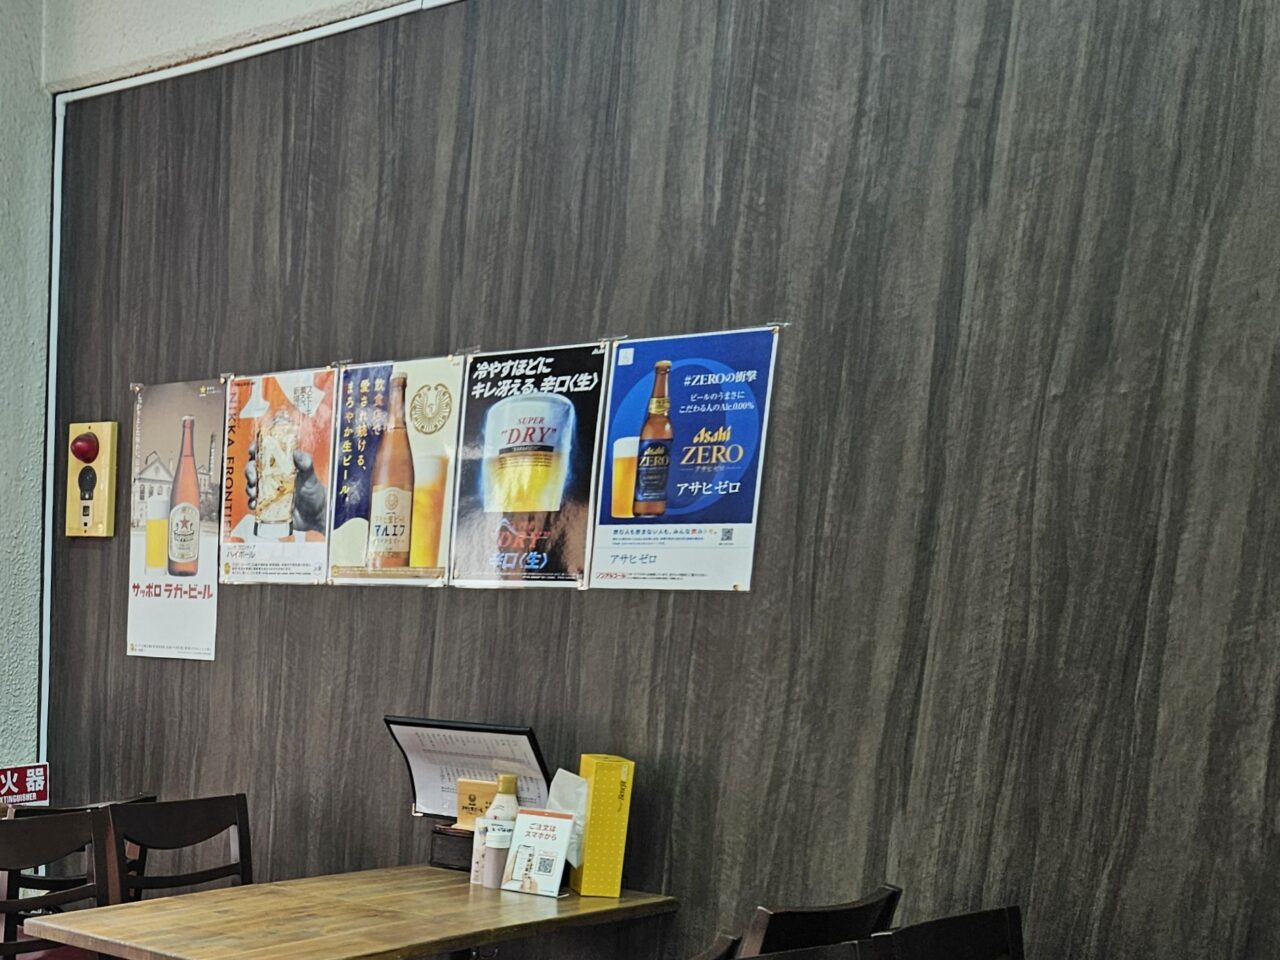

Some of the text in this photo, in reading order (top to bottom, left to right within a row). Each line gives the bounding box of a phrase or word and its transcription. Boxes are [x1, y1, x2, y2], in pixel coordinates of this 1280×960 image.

[473, 356, 554, 379] 冷やすほどに
[684, 370, 757, 387] #ZEROの衝撃
[690, 391, 745, 402] ビールのうまさに
[518, 416, 545, 425] SUPER
[693, 425, 732, 444] Asahi
[638, 456, 669, 467] ZERO
[680, 444, 744, 465] ZERO
[223, 391, 237, 537] NIKKA FRONTIER
[375, 524, 406, 537] マルエフ
[132, 583, 214, 599] サッポロ ラガービール
[529, 823, 556, 832] ご注文は
[524, 831, 557, 841] スマホから
